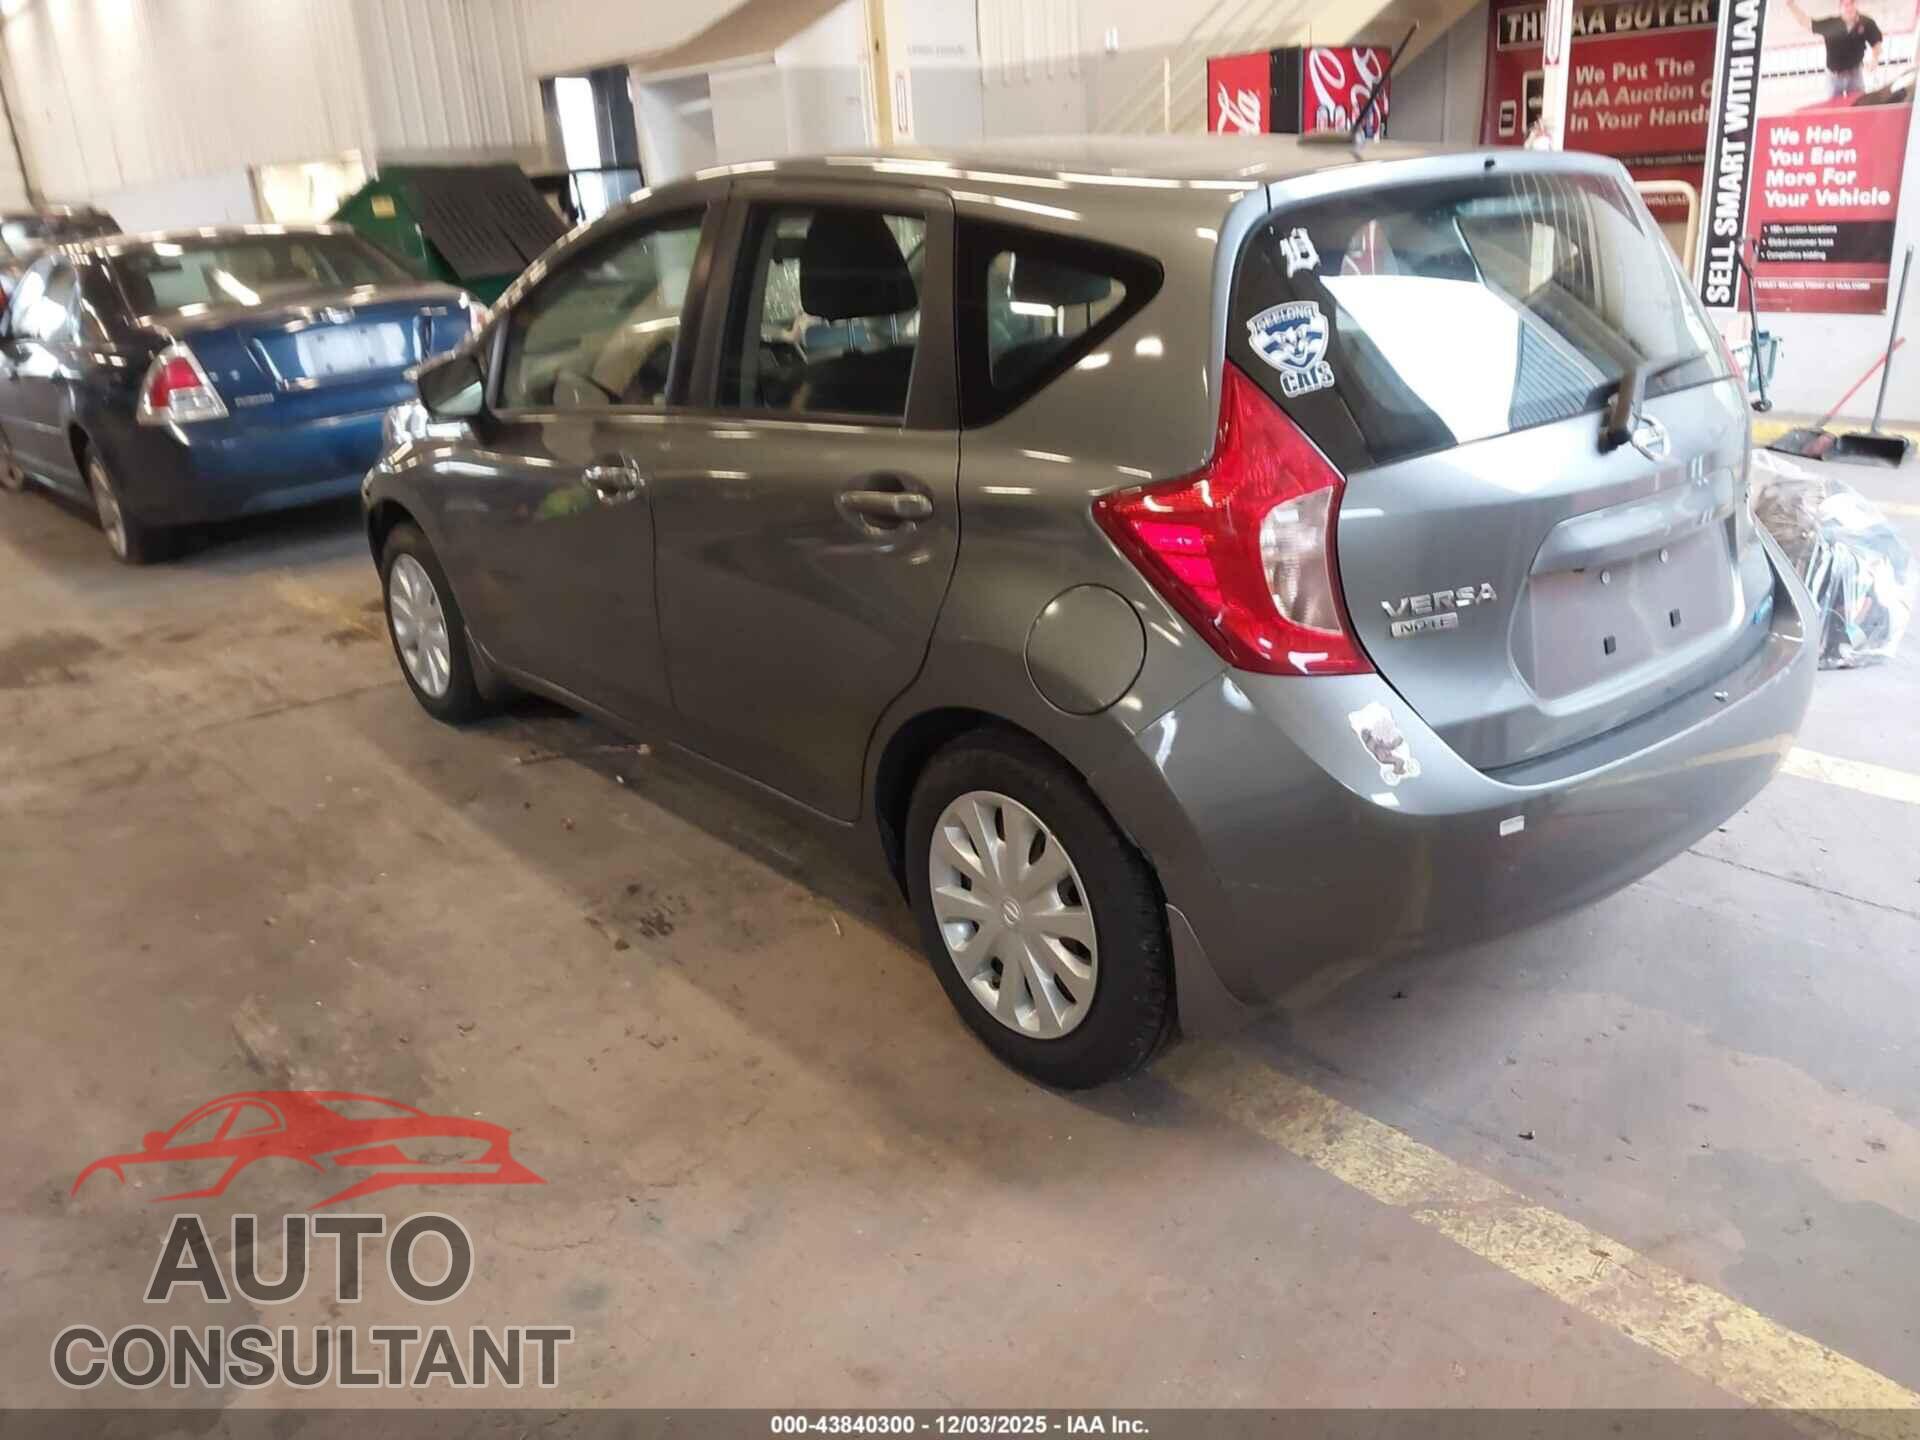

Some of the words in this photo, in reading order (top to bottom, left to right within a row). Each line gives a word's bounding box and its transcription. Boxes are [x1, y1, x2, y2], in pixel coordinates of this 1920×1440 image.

[1615, 0, 1709, 31] BUYER
[1732, 0, 1760, 50] IAA
[1575, 65, 1605, 85] We
[1613, 62, 1648, 81] Put
[1655, 57, 1695, 78] The
[1573, 88, 1610, 108] IAA
[1614, 82, 1694, 104] Auction
[1724, 56, 1754, 133] WITH
[1570, 113, 1588, 131] In
[1596, 111, 1642, 129] Your
[1770, 127, 1799, 146] We
[1806, 124, 1853, 146] Help
[1769, 148, 1804, 167] You
[1810, 146, 1856, 165] Earn
[1714, 137, 1746, 236] SMART
[1766, 169, 1817, 188] More
[1822, 168, 1856, 185] For
[1765, 189, 1809, 208] Your
[1815, 187, 1890, 206] Vehicle
[1706, 240, 1736, 303] SELL
[1281, 361, 1334, 393] CATS
[1381, 583, 1498, 617] VERSA
